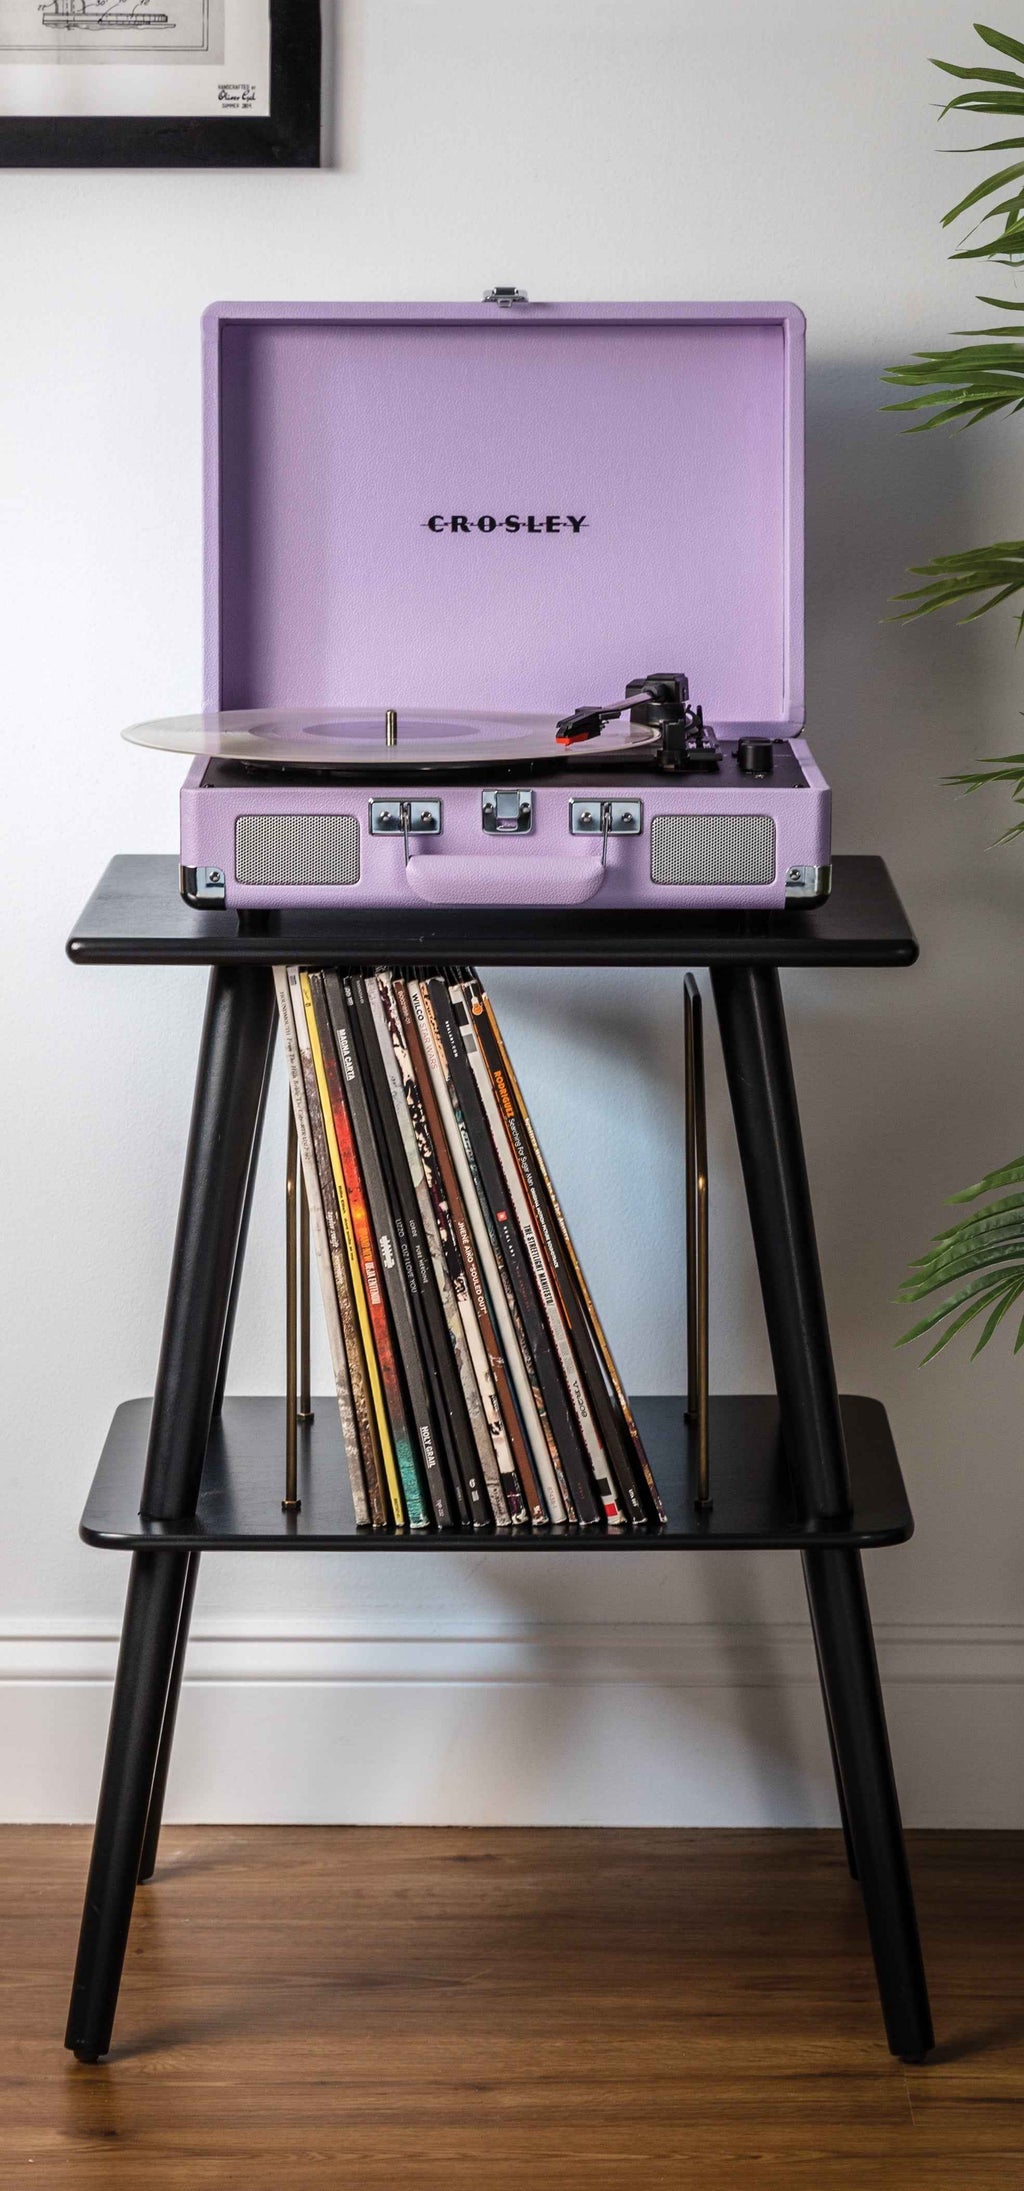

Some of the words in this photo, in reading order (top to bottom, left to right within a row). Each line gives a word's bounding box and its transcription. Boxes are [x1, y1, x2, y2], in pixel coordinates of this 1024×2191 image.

[427, 515, 587, 533] CROSLEY
[412, 993, 424, 1020] WILCO
[420, 1022, 430, 1043] STAR
[426, 1044, 438, 1069] WARS
[337, 1029, 350, 1056] MAGNA
[343, 1056, 355, 1081] CARTA
[493, 1070, 515, 1118] RODRIGUEZ
[508, 1118, 522, 1147] Searching
[517, 1147, 525, 1156] For
[520, 1156, 530, 1173] Sugar
[526, 1173, 534, 1187] Man
[326, 1211, 336, 1230] taylor
[395, 1218, 404, 1237] LIZZO
[409, 1219, 418, 1237] LORDE
[330, 1230, 339, 1248] swift
[523, 1224, 533, 1237] THE
[362, 1248, 373, 1262] NEW
[401, 1243, 410, 1257] CUZ
[464, 1245, 474, 1263] AIKO
[527, 1236, 544, 1272] STREETLIGHT
[405, 1260, 414, 1278] LOVE
[367, 1277, 381, 1304] ENTENDU
[572, 1380, 588, 1418] VR209
[420, 1425, 432, 1446] HOLY
[425, 1445, 436, 1469] GRAIL
